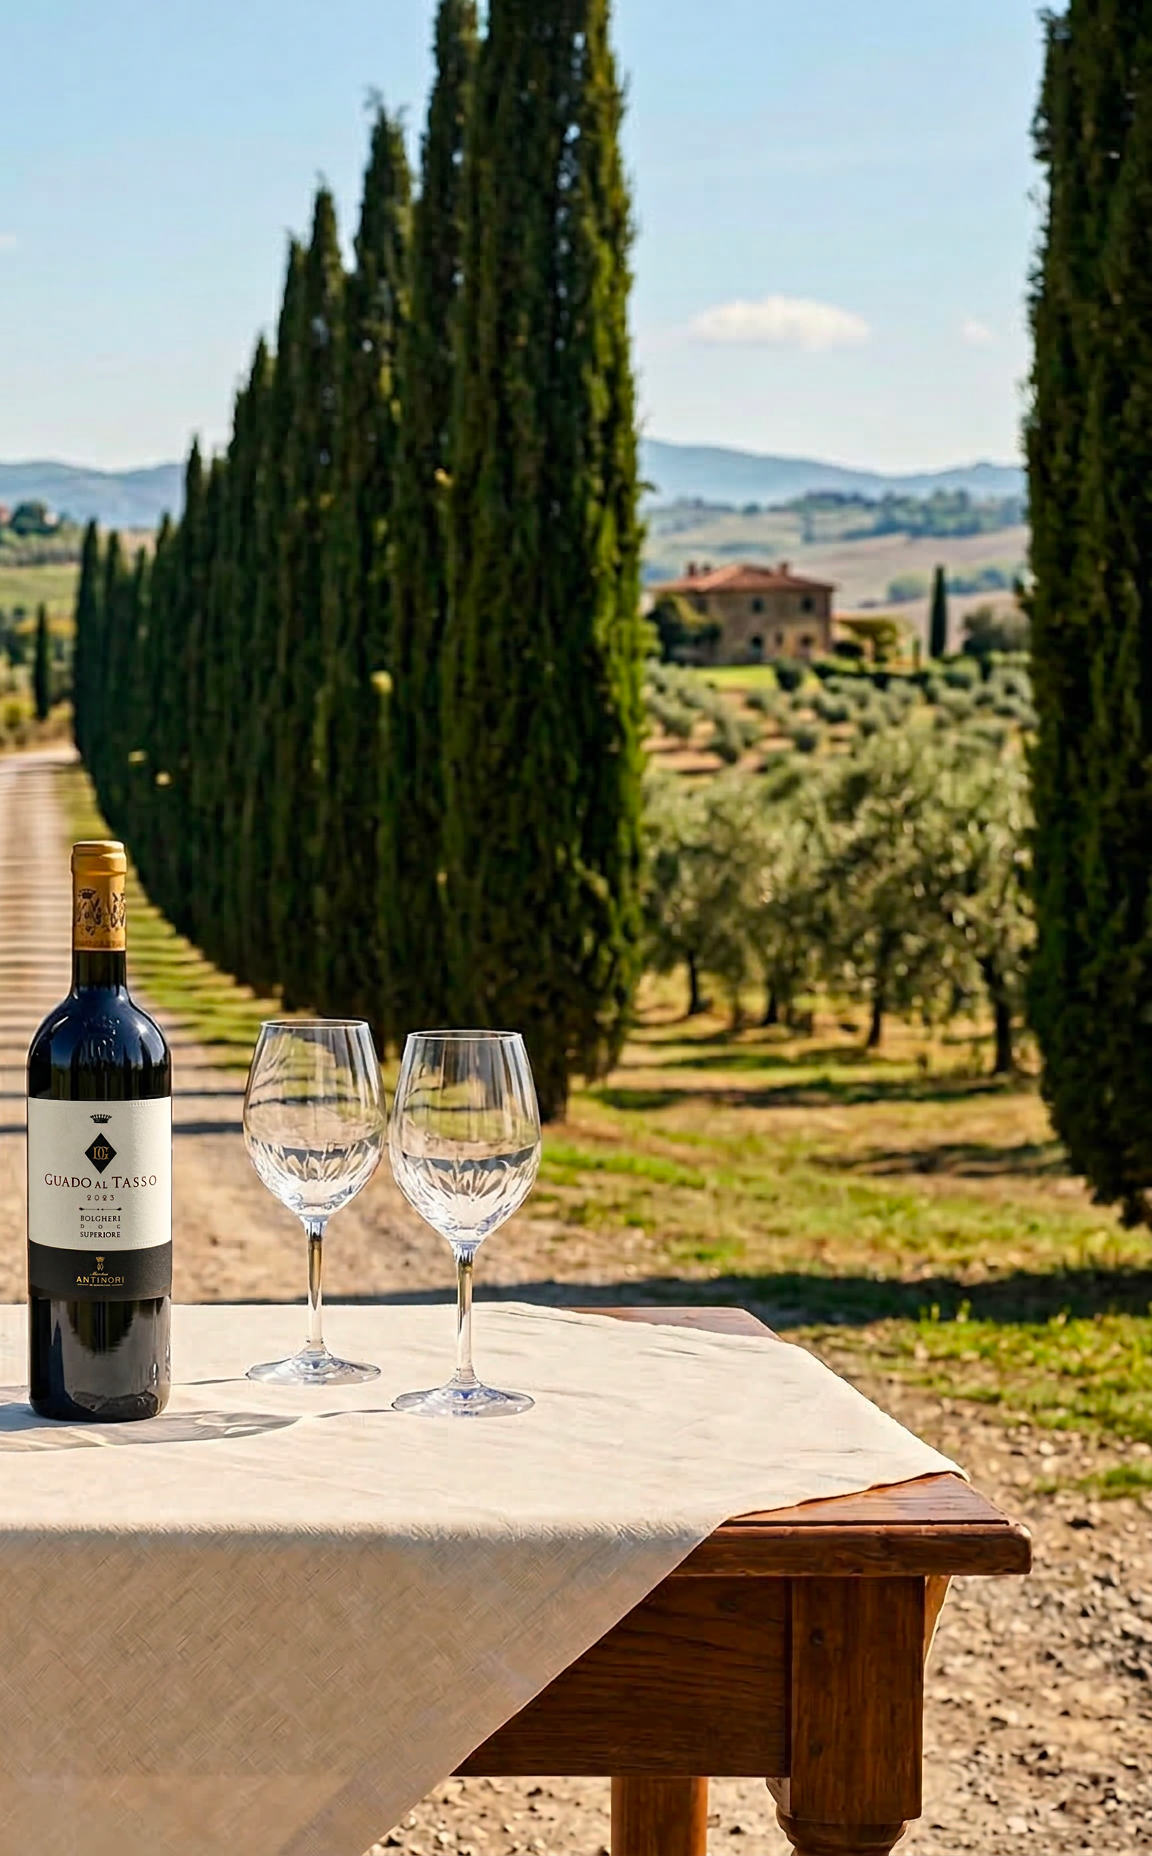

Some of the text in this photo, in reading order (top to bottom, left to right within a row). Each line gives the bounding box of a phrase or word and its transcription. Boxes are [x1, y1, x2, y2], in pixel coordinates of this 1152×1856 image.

[44, 1173, 157, 1189] GUADO AL TASSO
